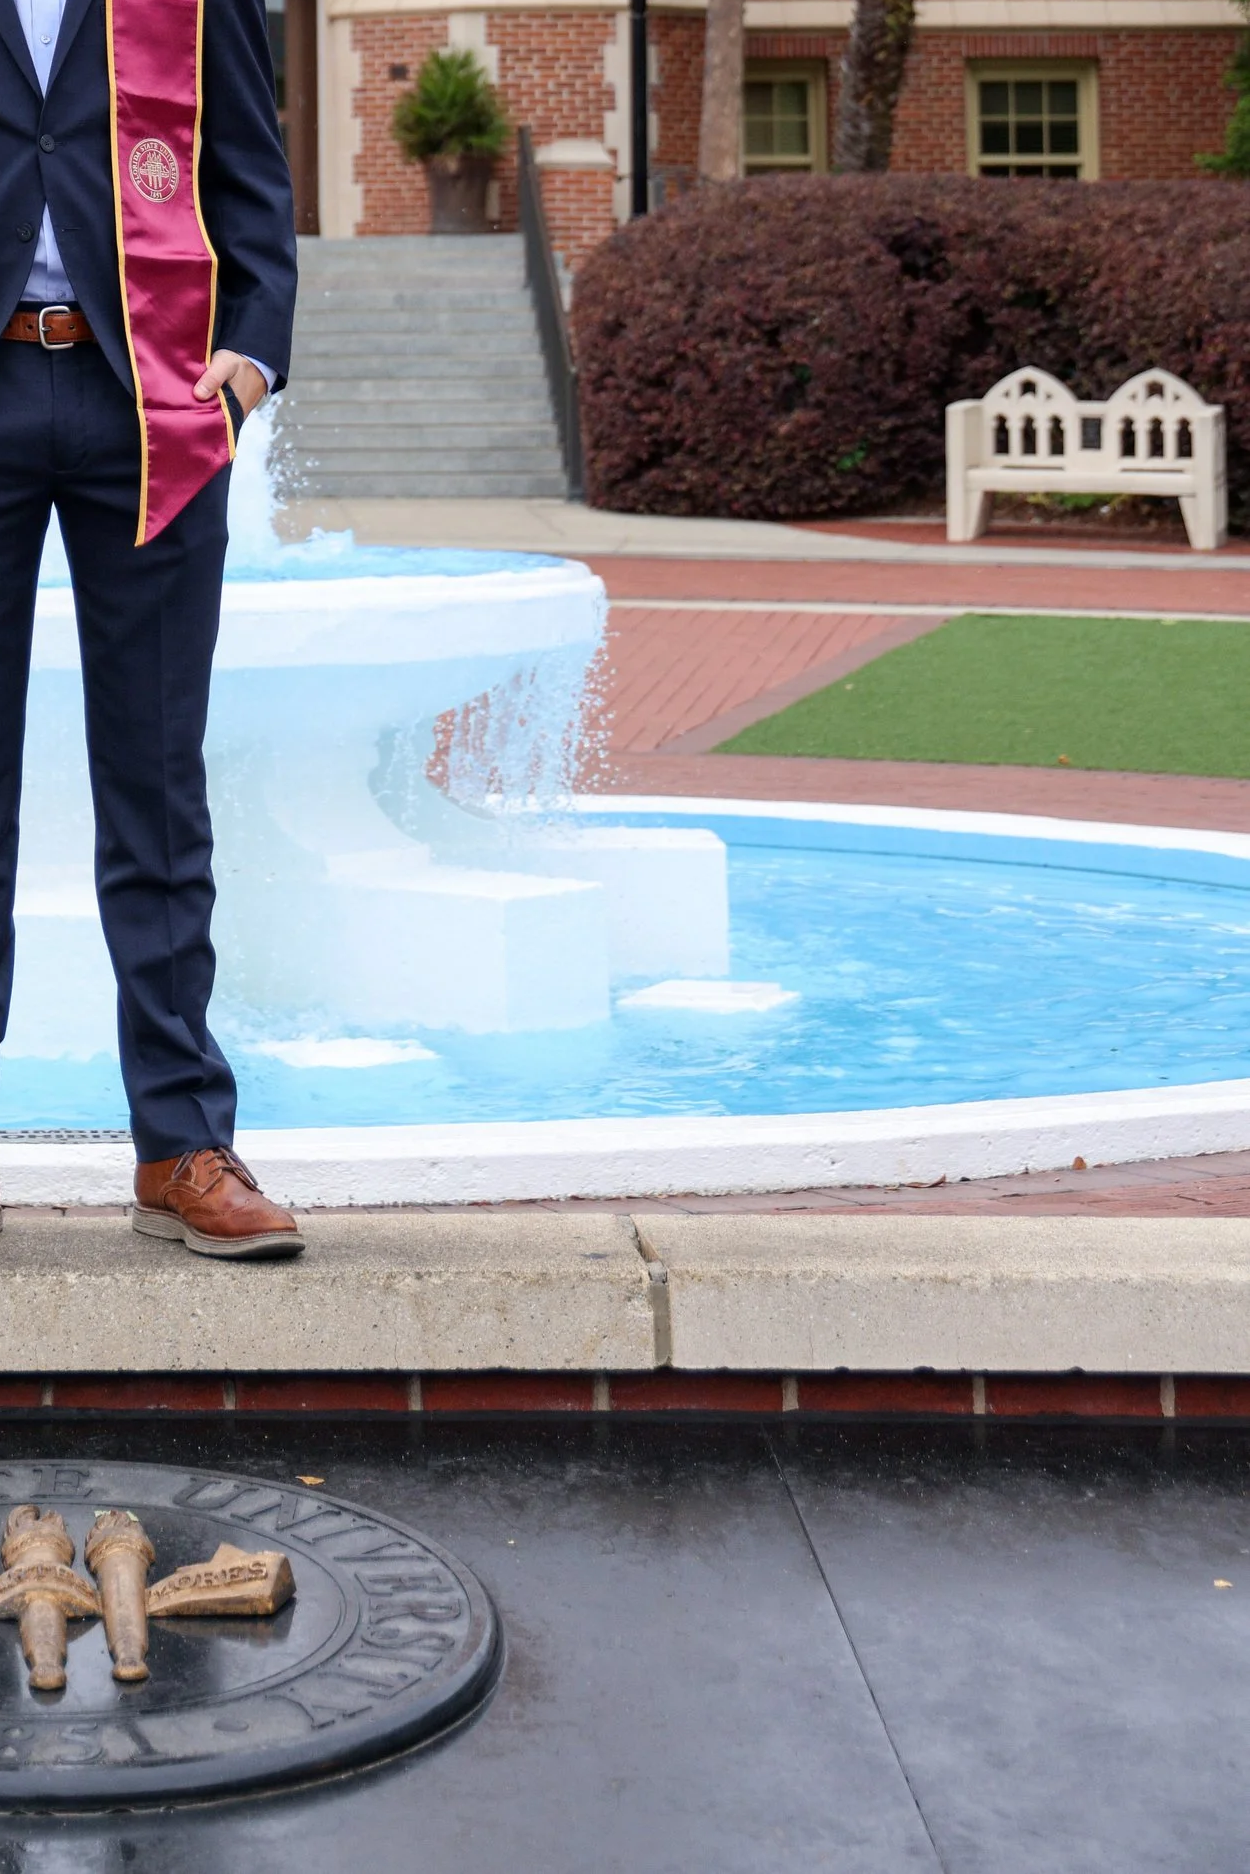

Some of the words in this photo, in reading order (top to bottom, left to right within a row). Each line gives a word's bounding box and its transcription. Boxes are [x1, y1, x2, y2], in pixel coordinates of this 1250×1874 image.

[132, 151, 142, 186] FLORIDA
[140, 142, 158, 152] STATE
[172, 1476, 463, 1730] UNIVERSITY
